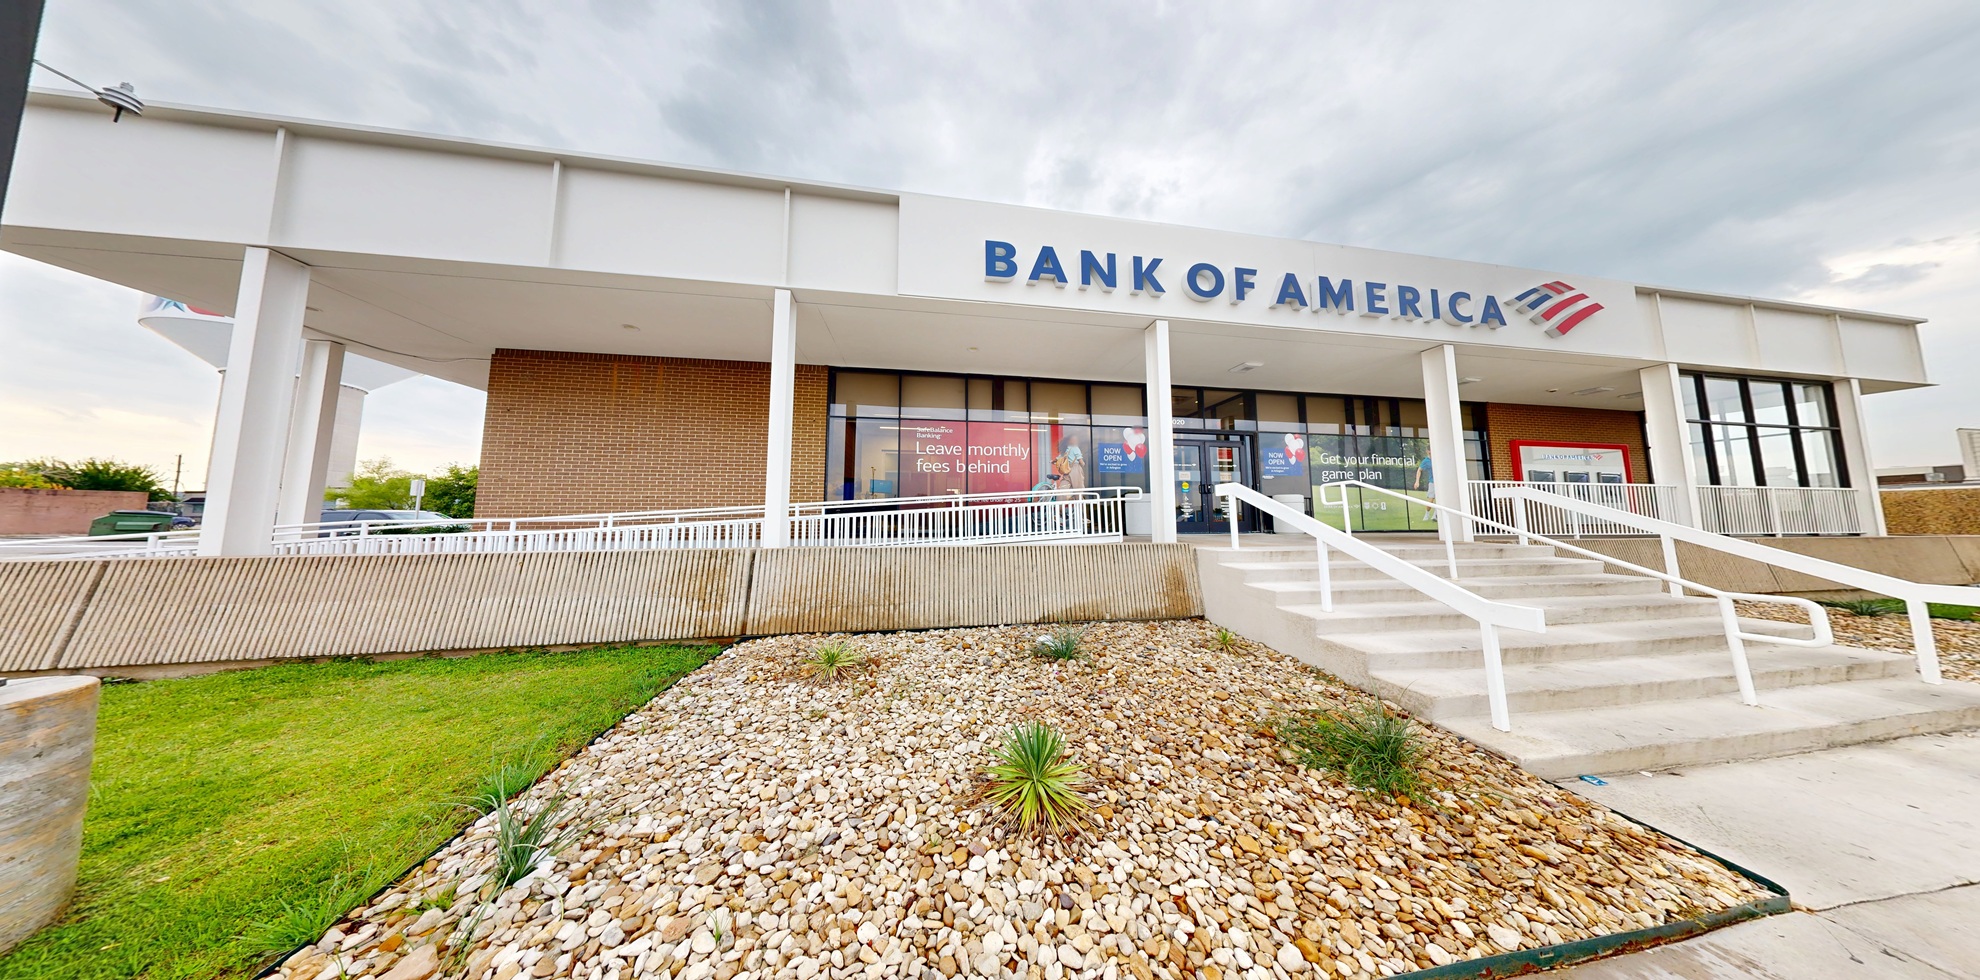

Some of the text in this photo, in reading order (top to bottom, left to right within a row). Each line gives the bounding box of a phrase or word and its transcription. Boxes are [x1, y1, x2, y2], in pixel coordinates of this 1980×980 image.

[984, 239, 1508, 328] BANK OF AMERICA
[916, 426, 954, 434] SafeBalance
[916, 441, 1030, 460] Leave monthly
[1103, 447, 1122, 455] NOW
[1103, 454, 1123, 462] OPEN
[1320, 453, 1415, 468] Get your financial
[916, 458, 1010, 474] fees behind
[1321, 468, 1382, 482] game plan
